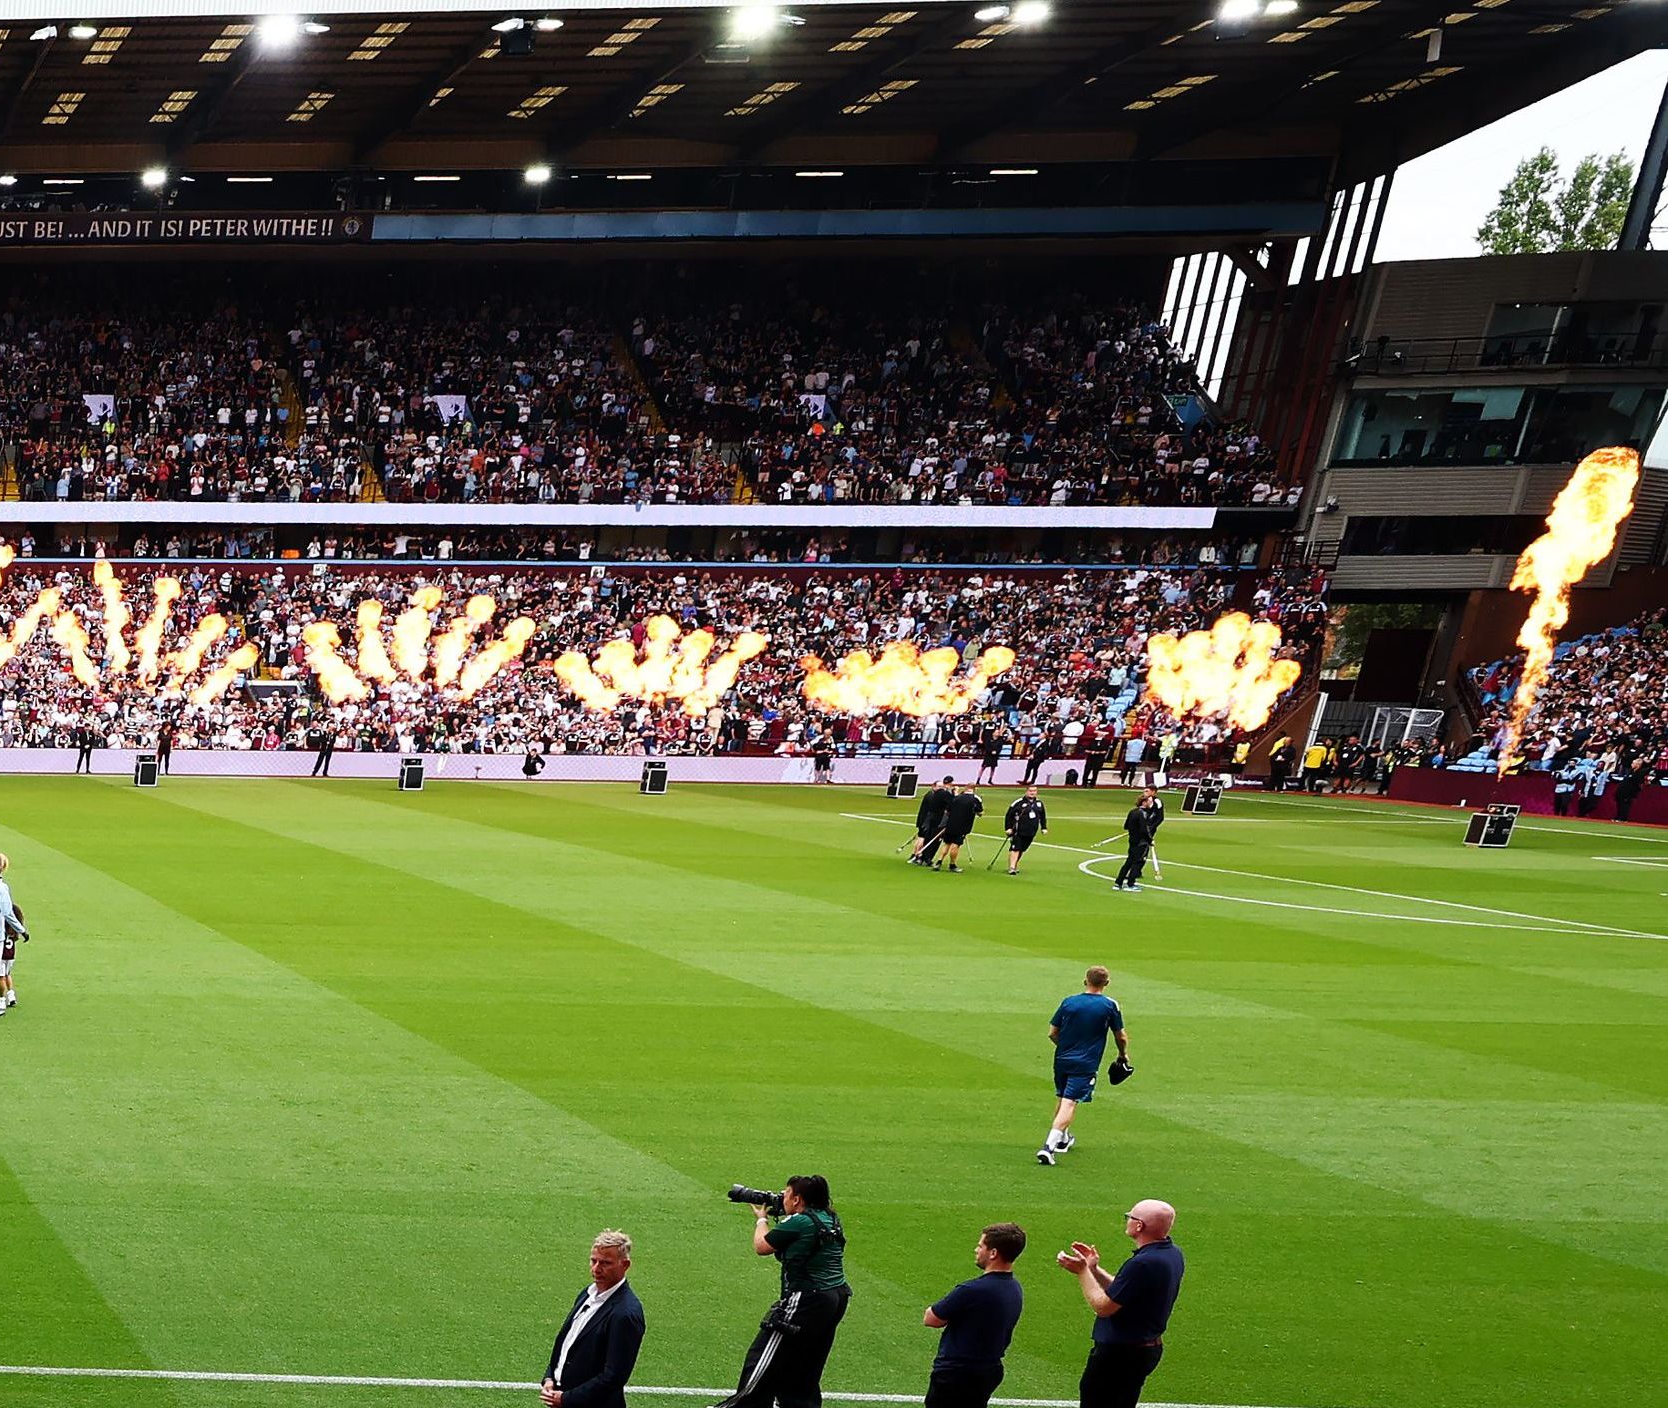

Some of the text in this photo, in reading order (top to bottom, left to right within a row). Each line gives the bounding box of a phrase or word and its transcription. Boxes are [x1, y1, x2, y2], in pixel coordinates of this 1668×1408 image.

[34, 221, 64, 238] BE!
[136, 220, 153, 238] IT
[160, 219, 184, 237] IS!
[188, 219, 249, 237] PETER
